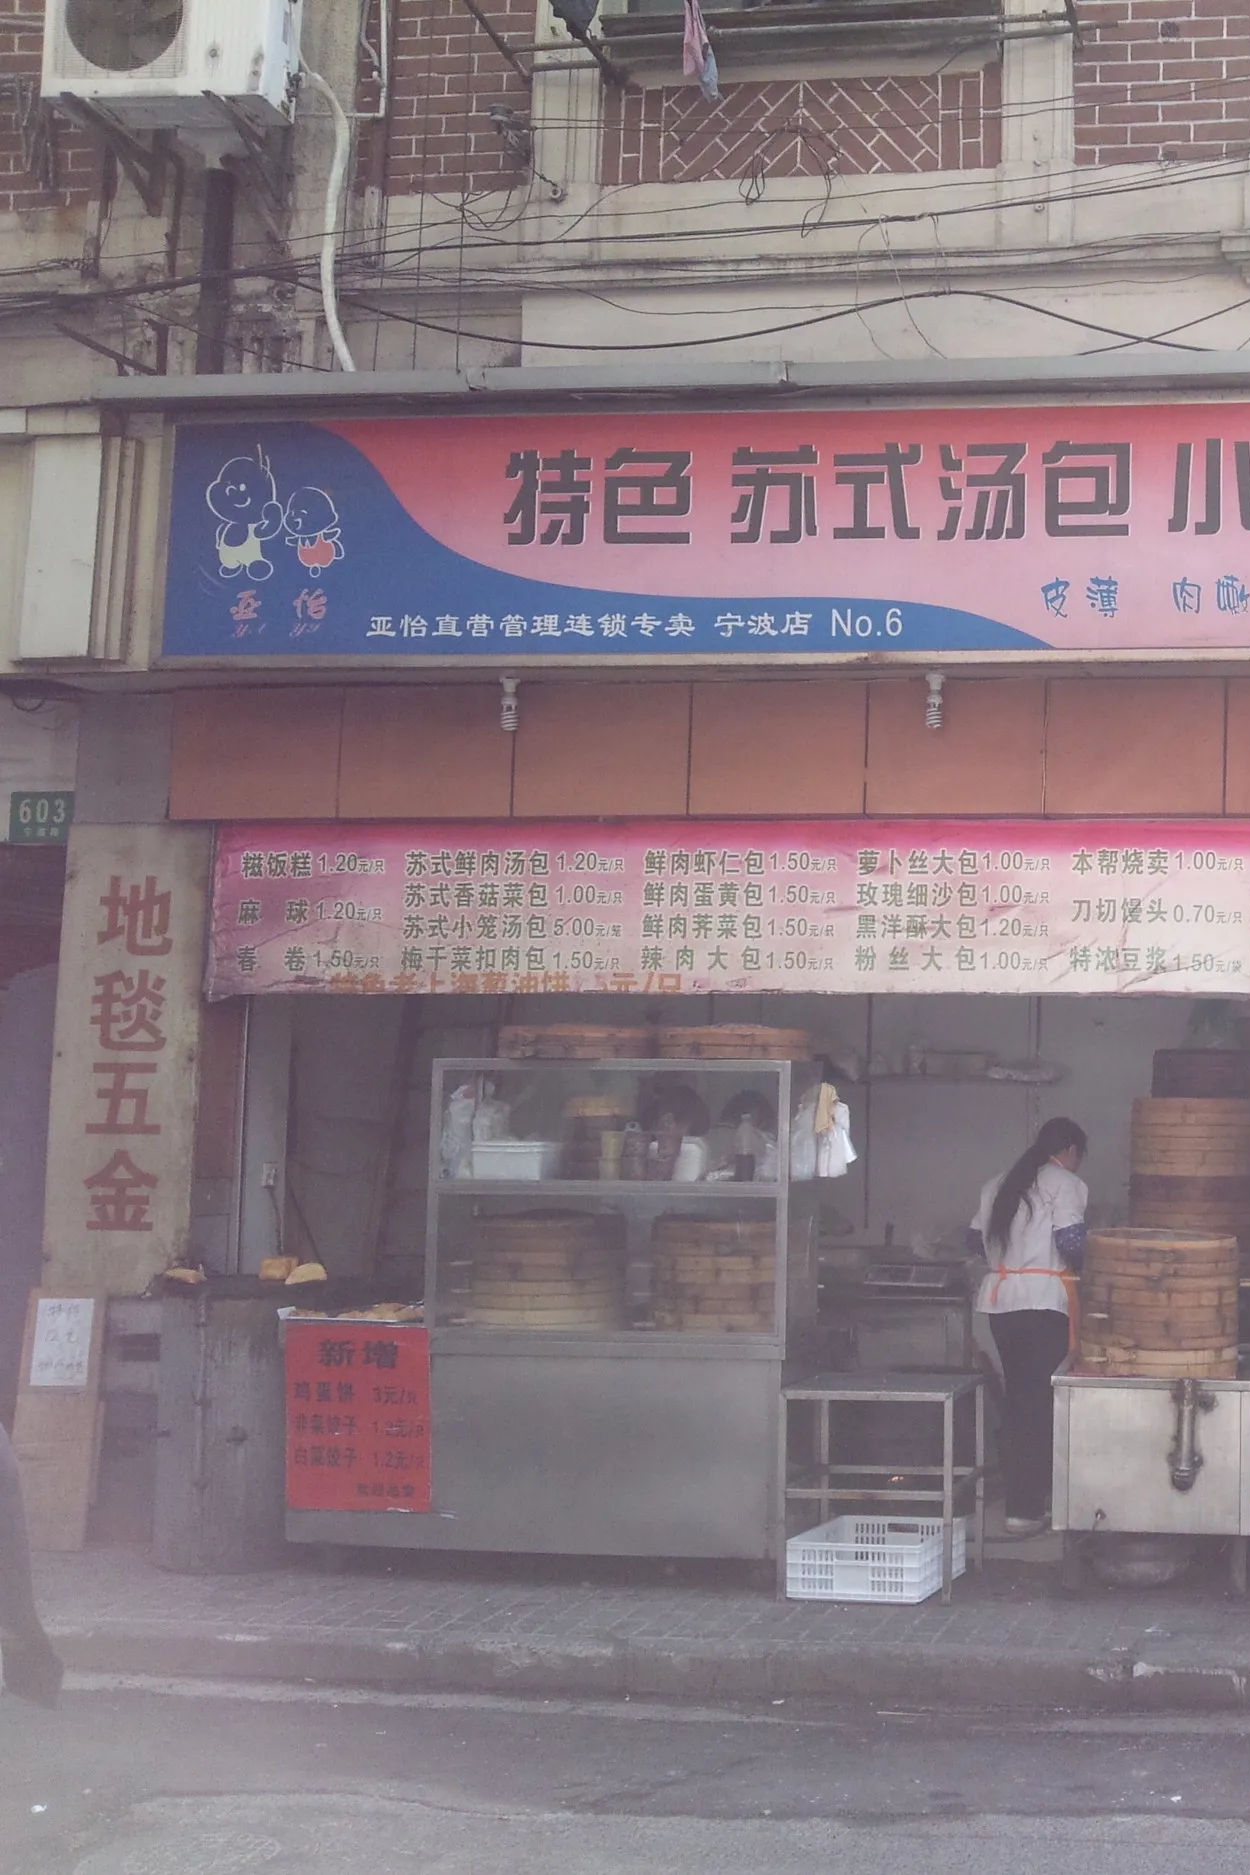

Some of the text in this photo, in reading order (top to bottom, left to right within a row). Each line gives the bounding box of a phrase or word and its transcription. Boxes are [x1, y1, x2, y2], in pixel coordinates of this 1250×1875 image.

[366, 608, 903, 639] 亚怡直营管理连锁专卖 宁波店 No.6
[19, 799, 66, 823] 603
[83, 875, 174, 1232] 地毯五金
